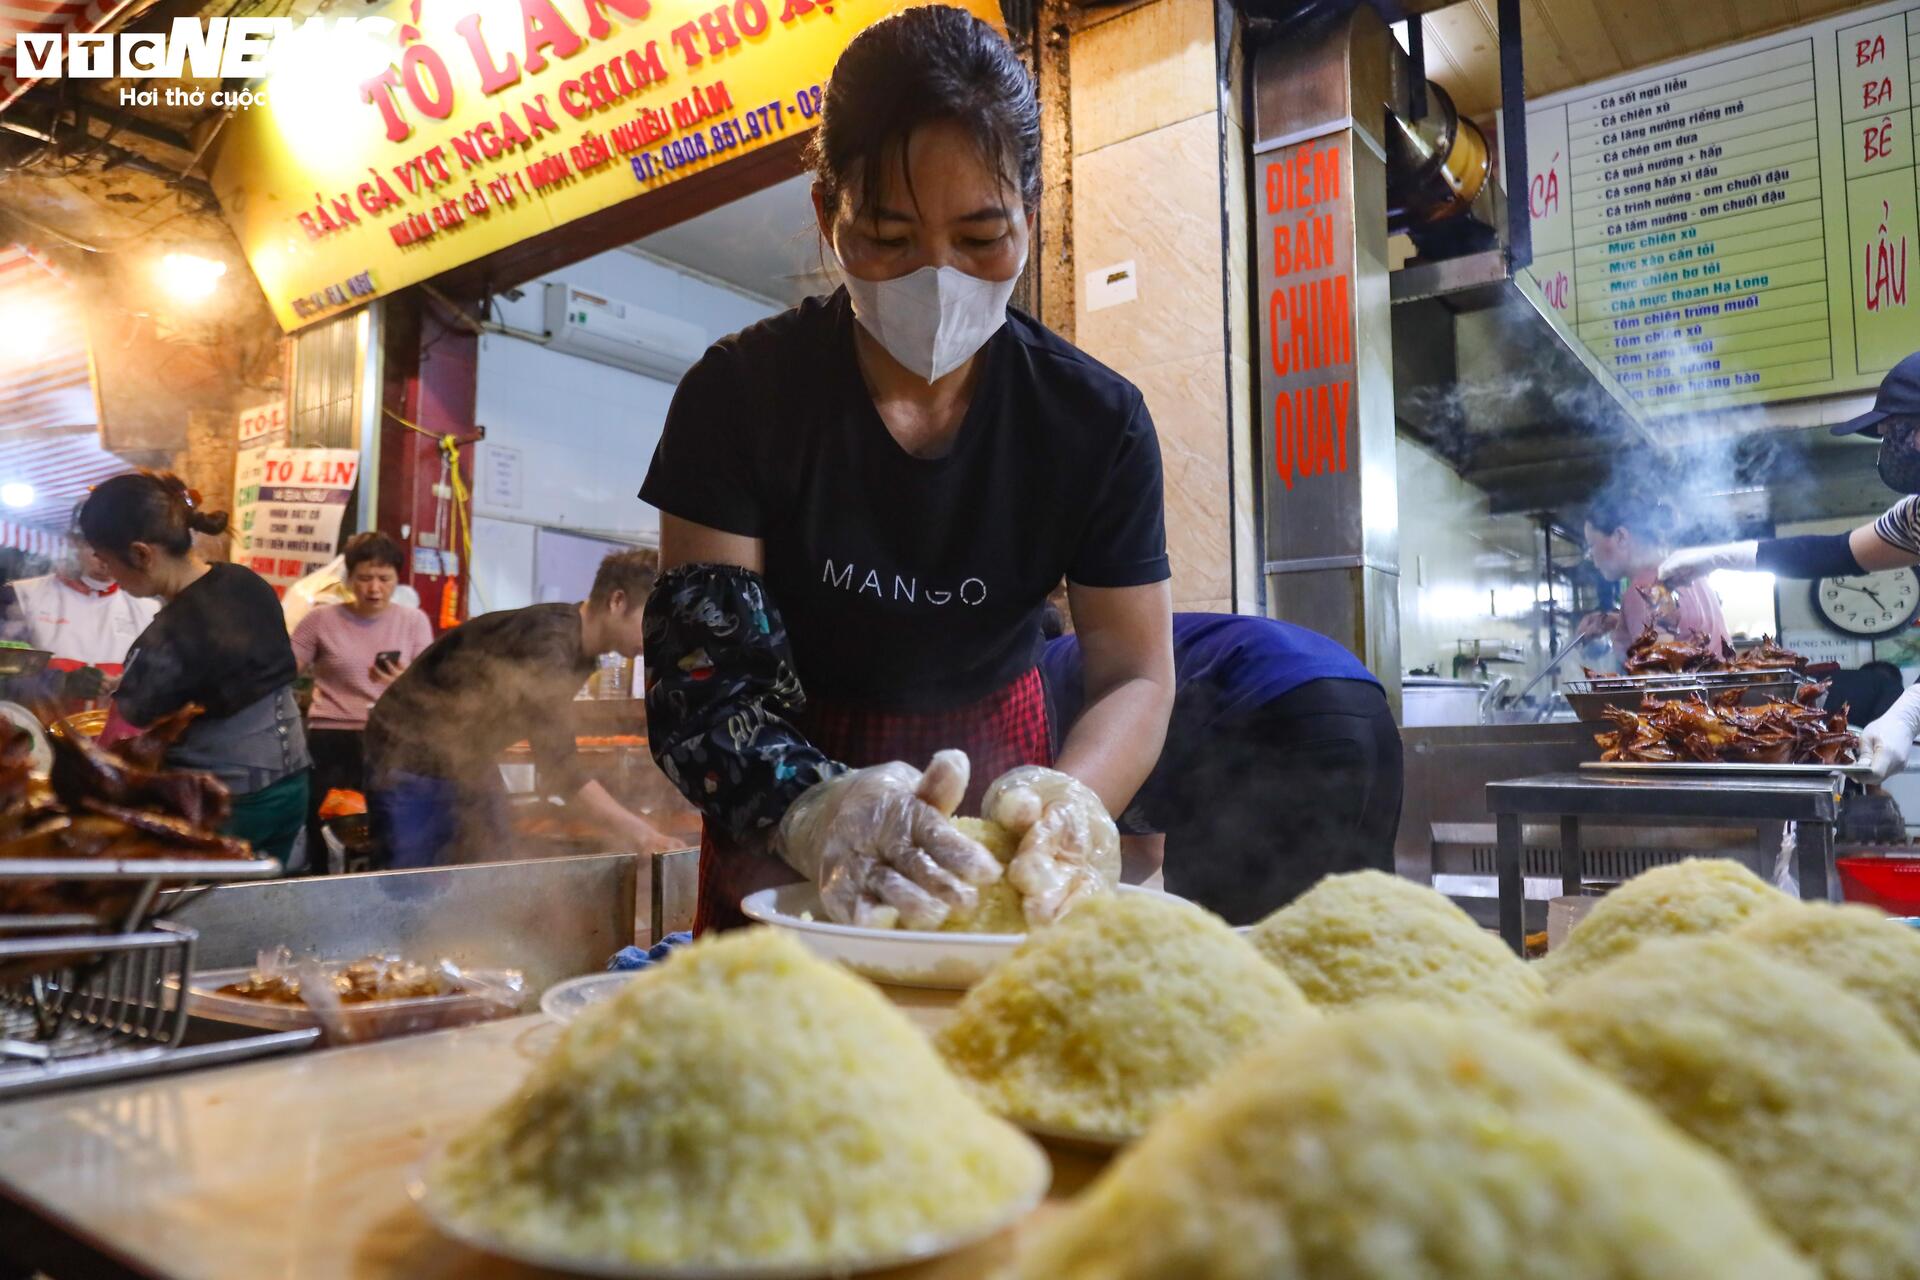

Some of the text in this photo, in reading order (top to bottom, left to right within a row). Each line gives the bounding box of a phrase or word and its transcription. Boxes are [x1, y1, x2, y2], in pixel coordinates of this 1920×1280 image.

[1856, 34, 1885, 68] BA
[1600, 97, 1616, 110] Cá
[1619, 92, 1637, 106] sốt
[1862, 76, 1892, 109] BA
[1601, 114, 1617, 127] Cá
[1620, 107, 1653, 123] chiên
[357, 167, 402, 214] GÀ
[393, 145, 451, 196] VỊT
[450, 94, 558, 171] NGAN
[559, 40, 668, 118] CHIM
[1602, 133, 1618, 146] Cá
[1603, 151, 1619, 164] Cá
[1622, 142, 1650, 159] chép
[1653, 140, 1672, 152] om
[1265, 139, 1340, 216] ĐIỂM
[1604, 169, 1620, 182] Cá
[1529, 152, 1560, 220] CÁ
[1605, 187, 1621, 200] Cá
[1623, 181, 1652, 196] song
[1606, 204, 1622, 217] Cá
[1703, 184, 1723, 197] om
[1607, 223, 1623, 236] Cá
[1699, 204, 1720, 218] om
[1273, 210, 1334, 278] BÁN
[1640, 232, 1677, 249] chiên
[1865, 201, 1907, 312] LẨU
[1642, 269, 1679, 287] chiên
[1735, 273, 1769, 290] Long
[1270, 275, 1350, 378] CHIM
[1614, 317, 1640, 331] Tôm
[1644, 307, 1681, 325] chiên
[1614, 336, 1641, 349] Tôm
[1615, 353, 1642, 367] Tôm
[1274, 380, 1349, 492] QUAY
[822, 558, 987, 606] MANGO
[1895, 571, 1904, 581] 2
[1827, 590, 1838, 600] 9
[1900, 585, 1911, 596] 3
[1834, 604, 1844, 614] 8
[1848, 612, 1857, 622] 7
[1882, 611, 1893, 621] 5
[1863, 617, 1876, 627] 6
